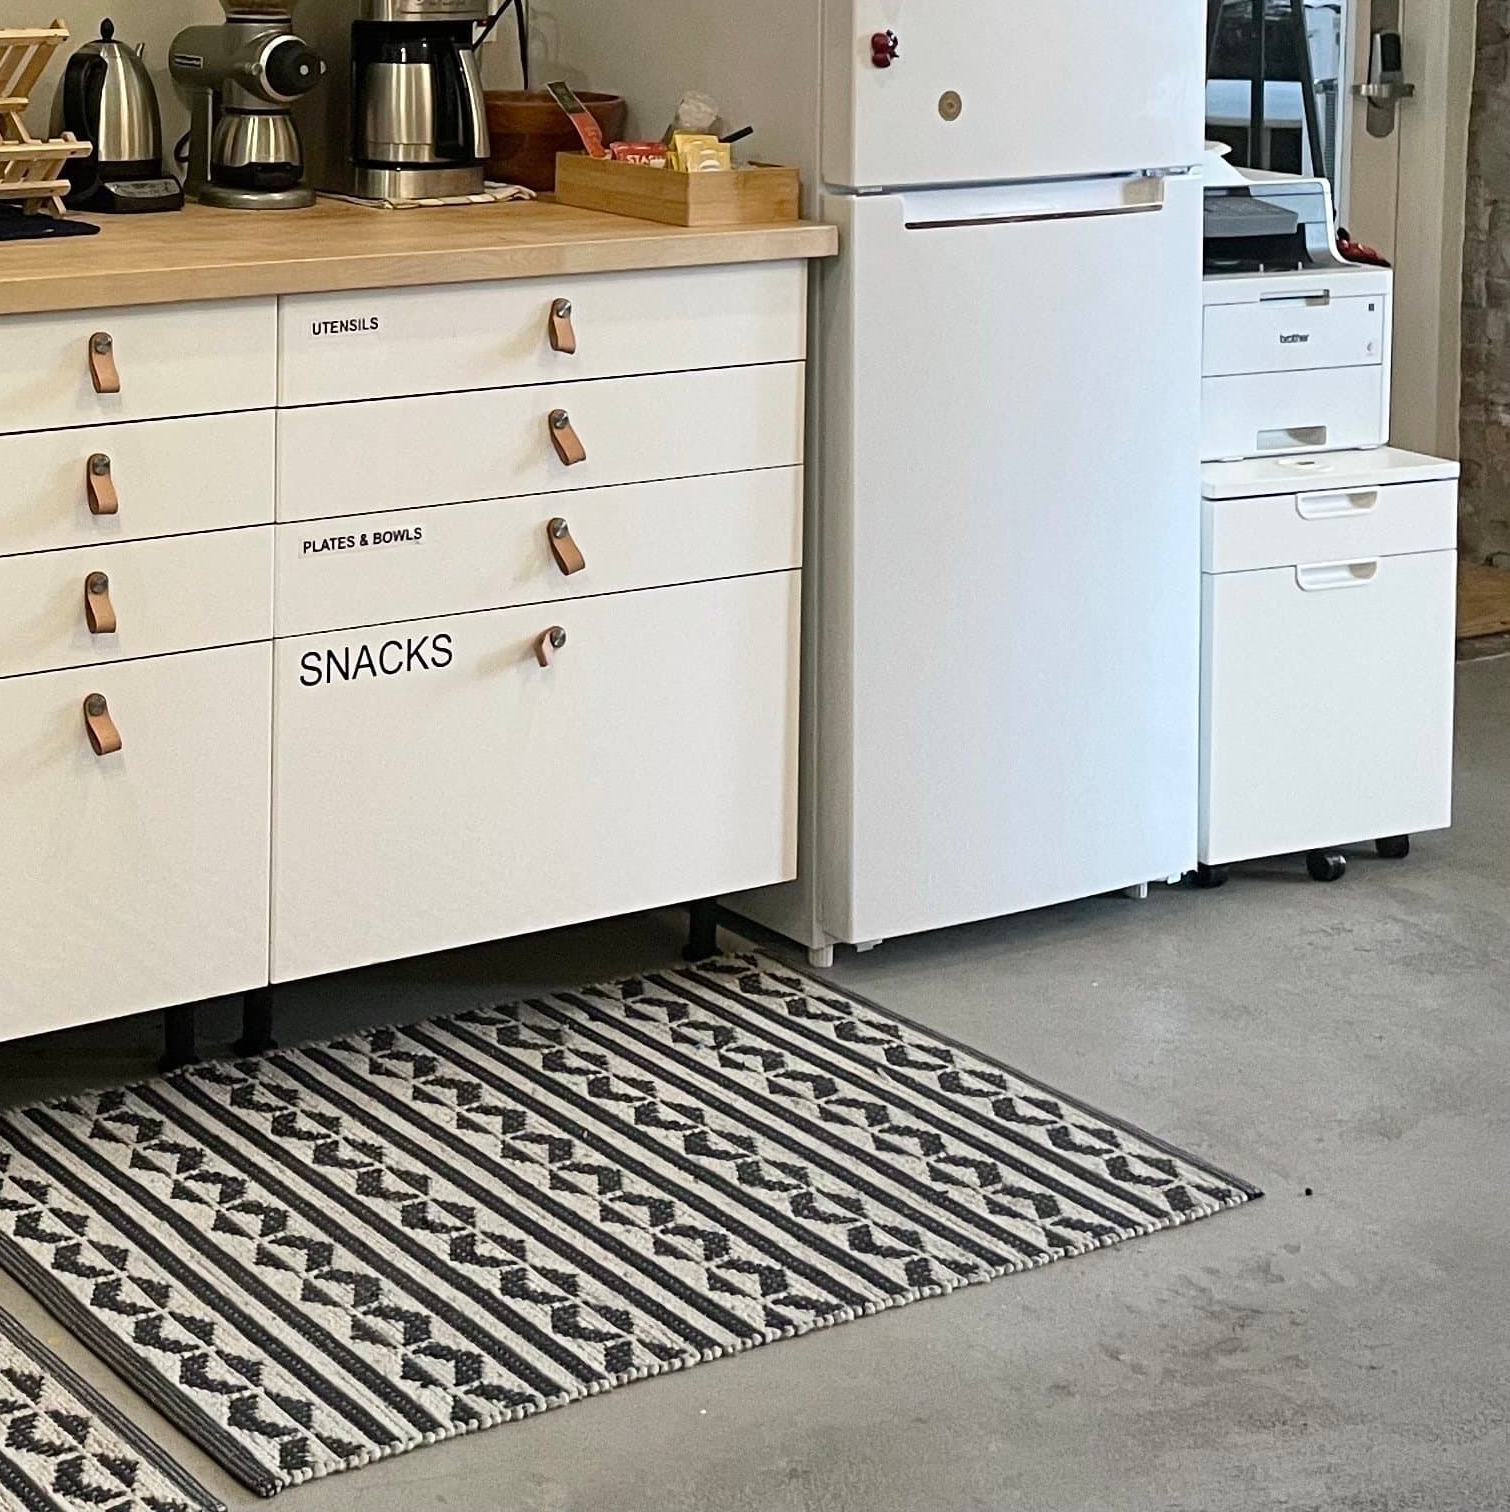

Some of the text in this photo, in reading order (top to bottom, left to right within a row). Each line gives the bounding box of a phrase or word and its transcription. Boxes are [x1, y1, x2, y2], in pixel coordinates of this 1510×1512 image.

[312, 317, 379, 335] UTENSILS
[303, 527, 423, 554] PLATES & BOWLS
[300, 633, 453, 687] SNACKS
